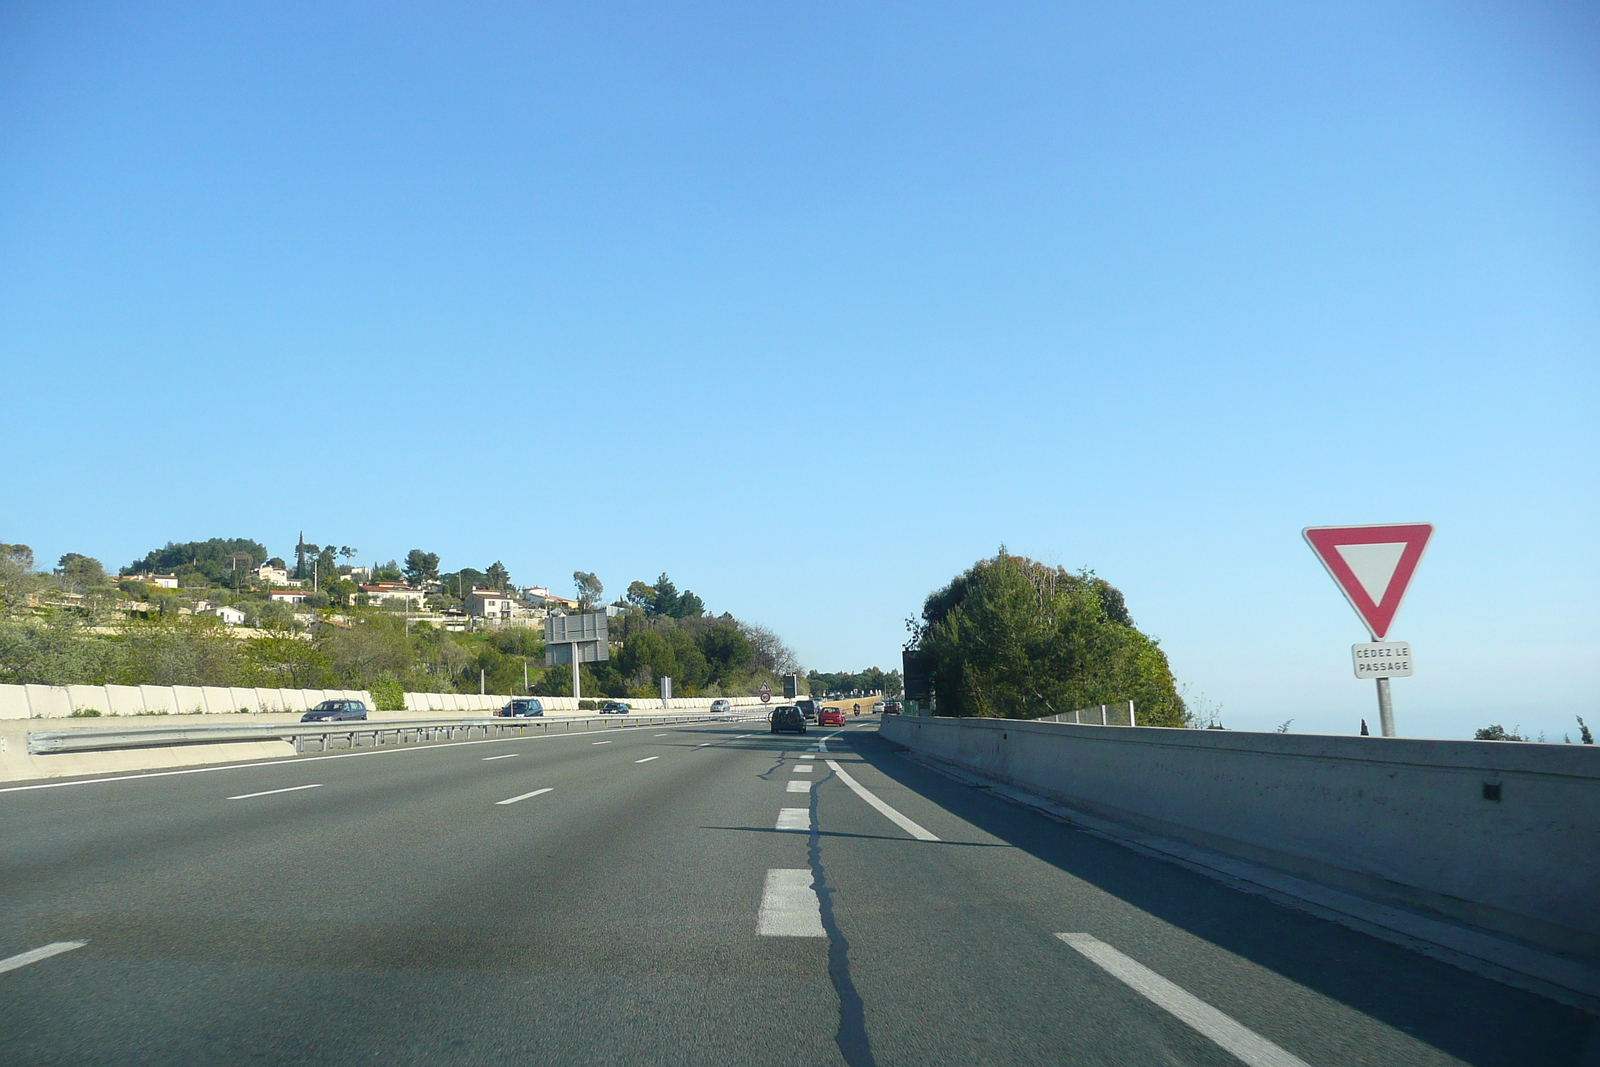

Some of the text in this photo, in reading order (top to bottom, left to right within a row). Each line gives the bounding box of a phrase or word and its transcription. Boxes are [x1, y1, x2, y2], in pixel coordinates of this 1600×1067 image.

[1356, 647, 1409, 658] CÉDEZ LE
[1359, 661, 1409, 672] PASSAGE
